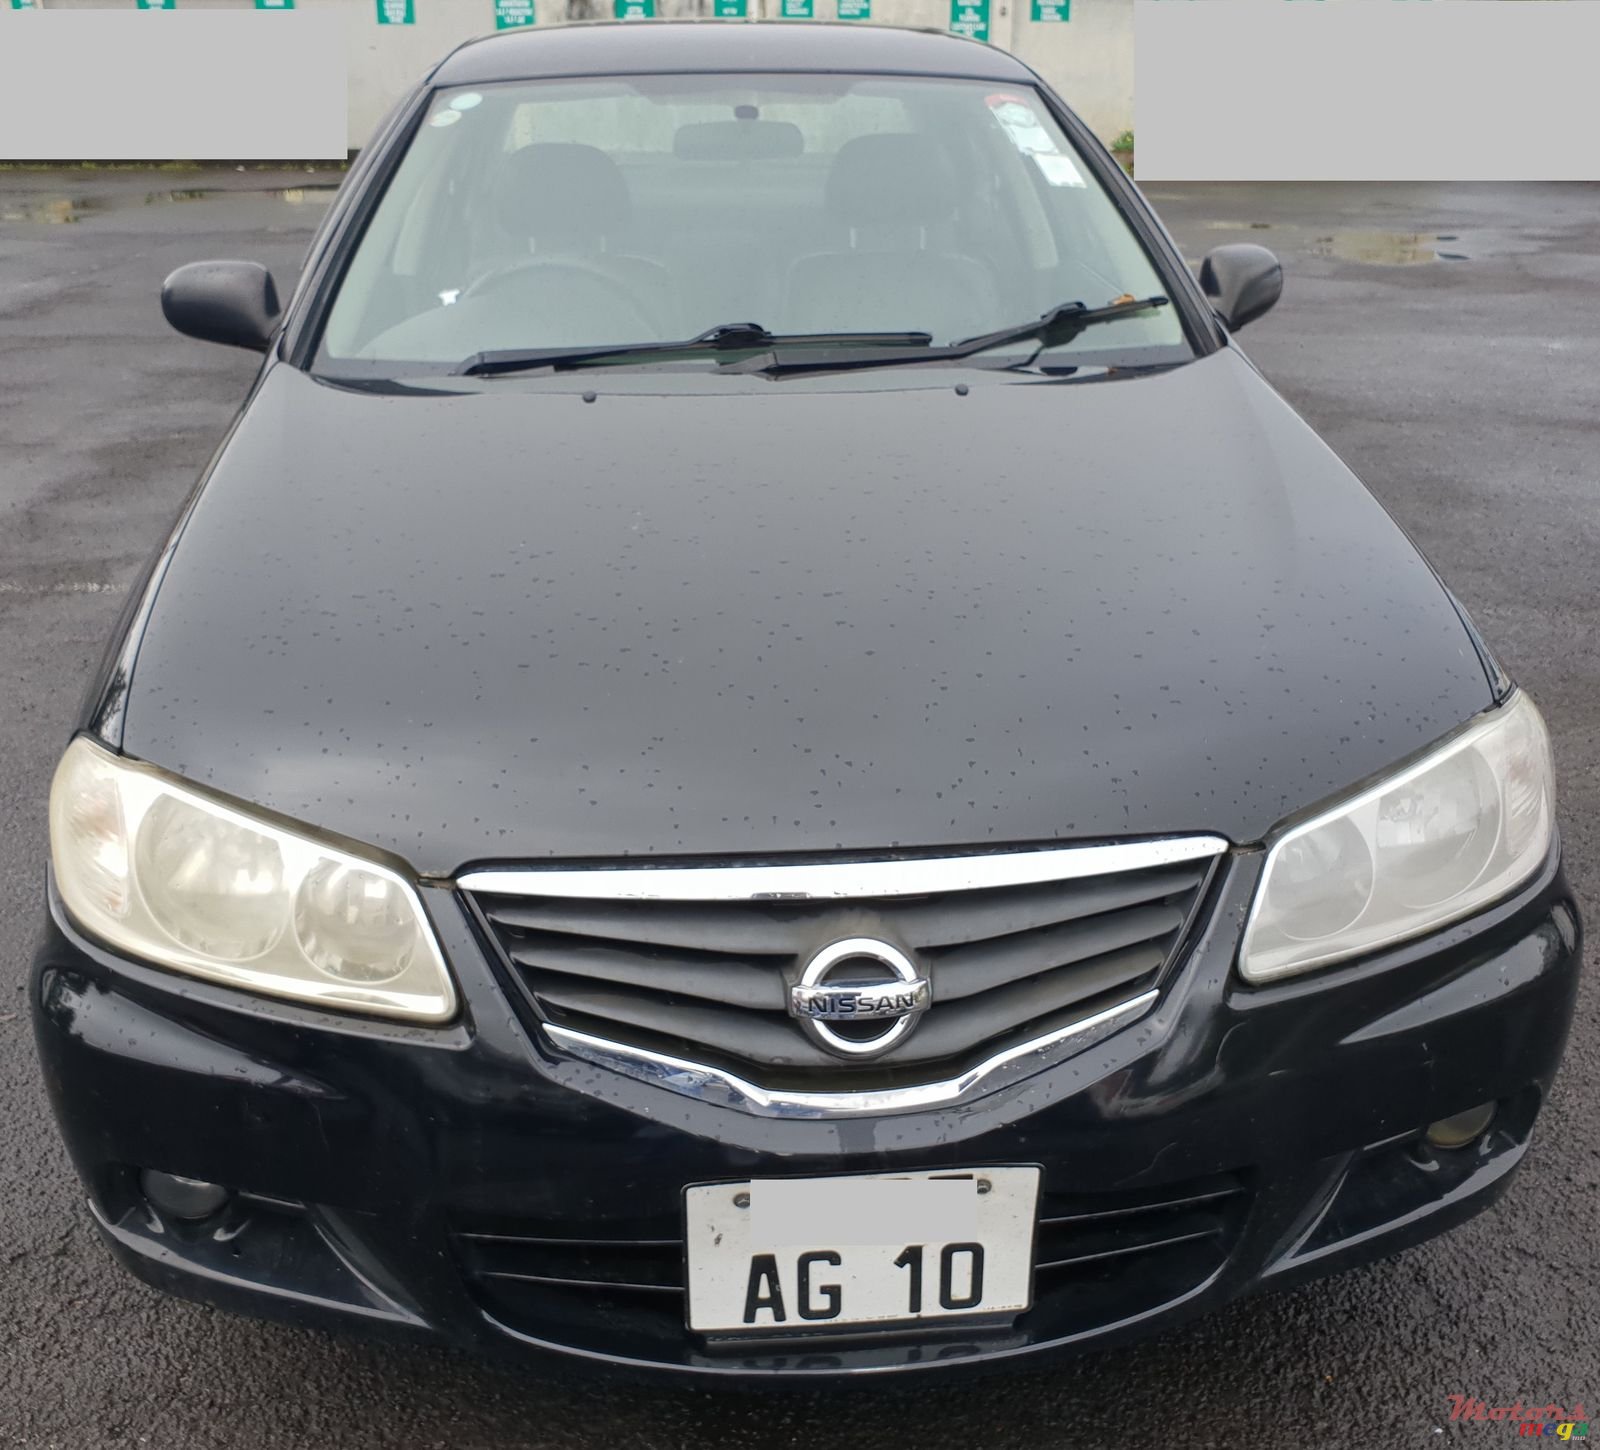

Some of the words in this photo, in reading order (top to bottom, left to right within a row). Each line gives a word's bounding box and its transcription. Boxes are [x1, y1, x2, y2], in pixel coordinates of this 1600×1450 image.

[808, 993, 914, 1013] NISSAN
[743, 1250, 842, 1323] AG
[894, 1242, 985, 1313] 10
